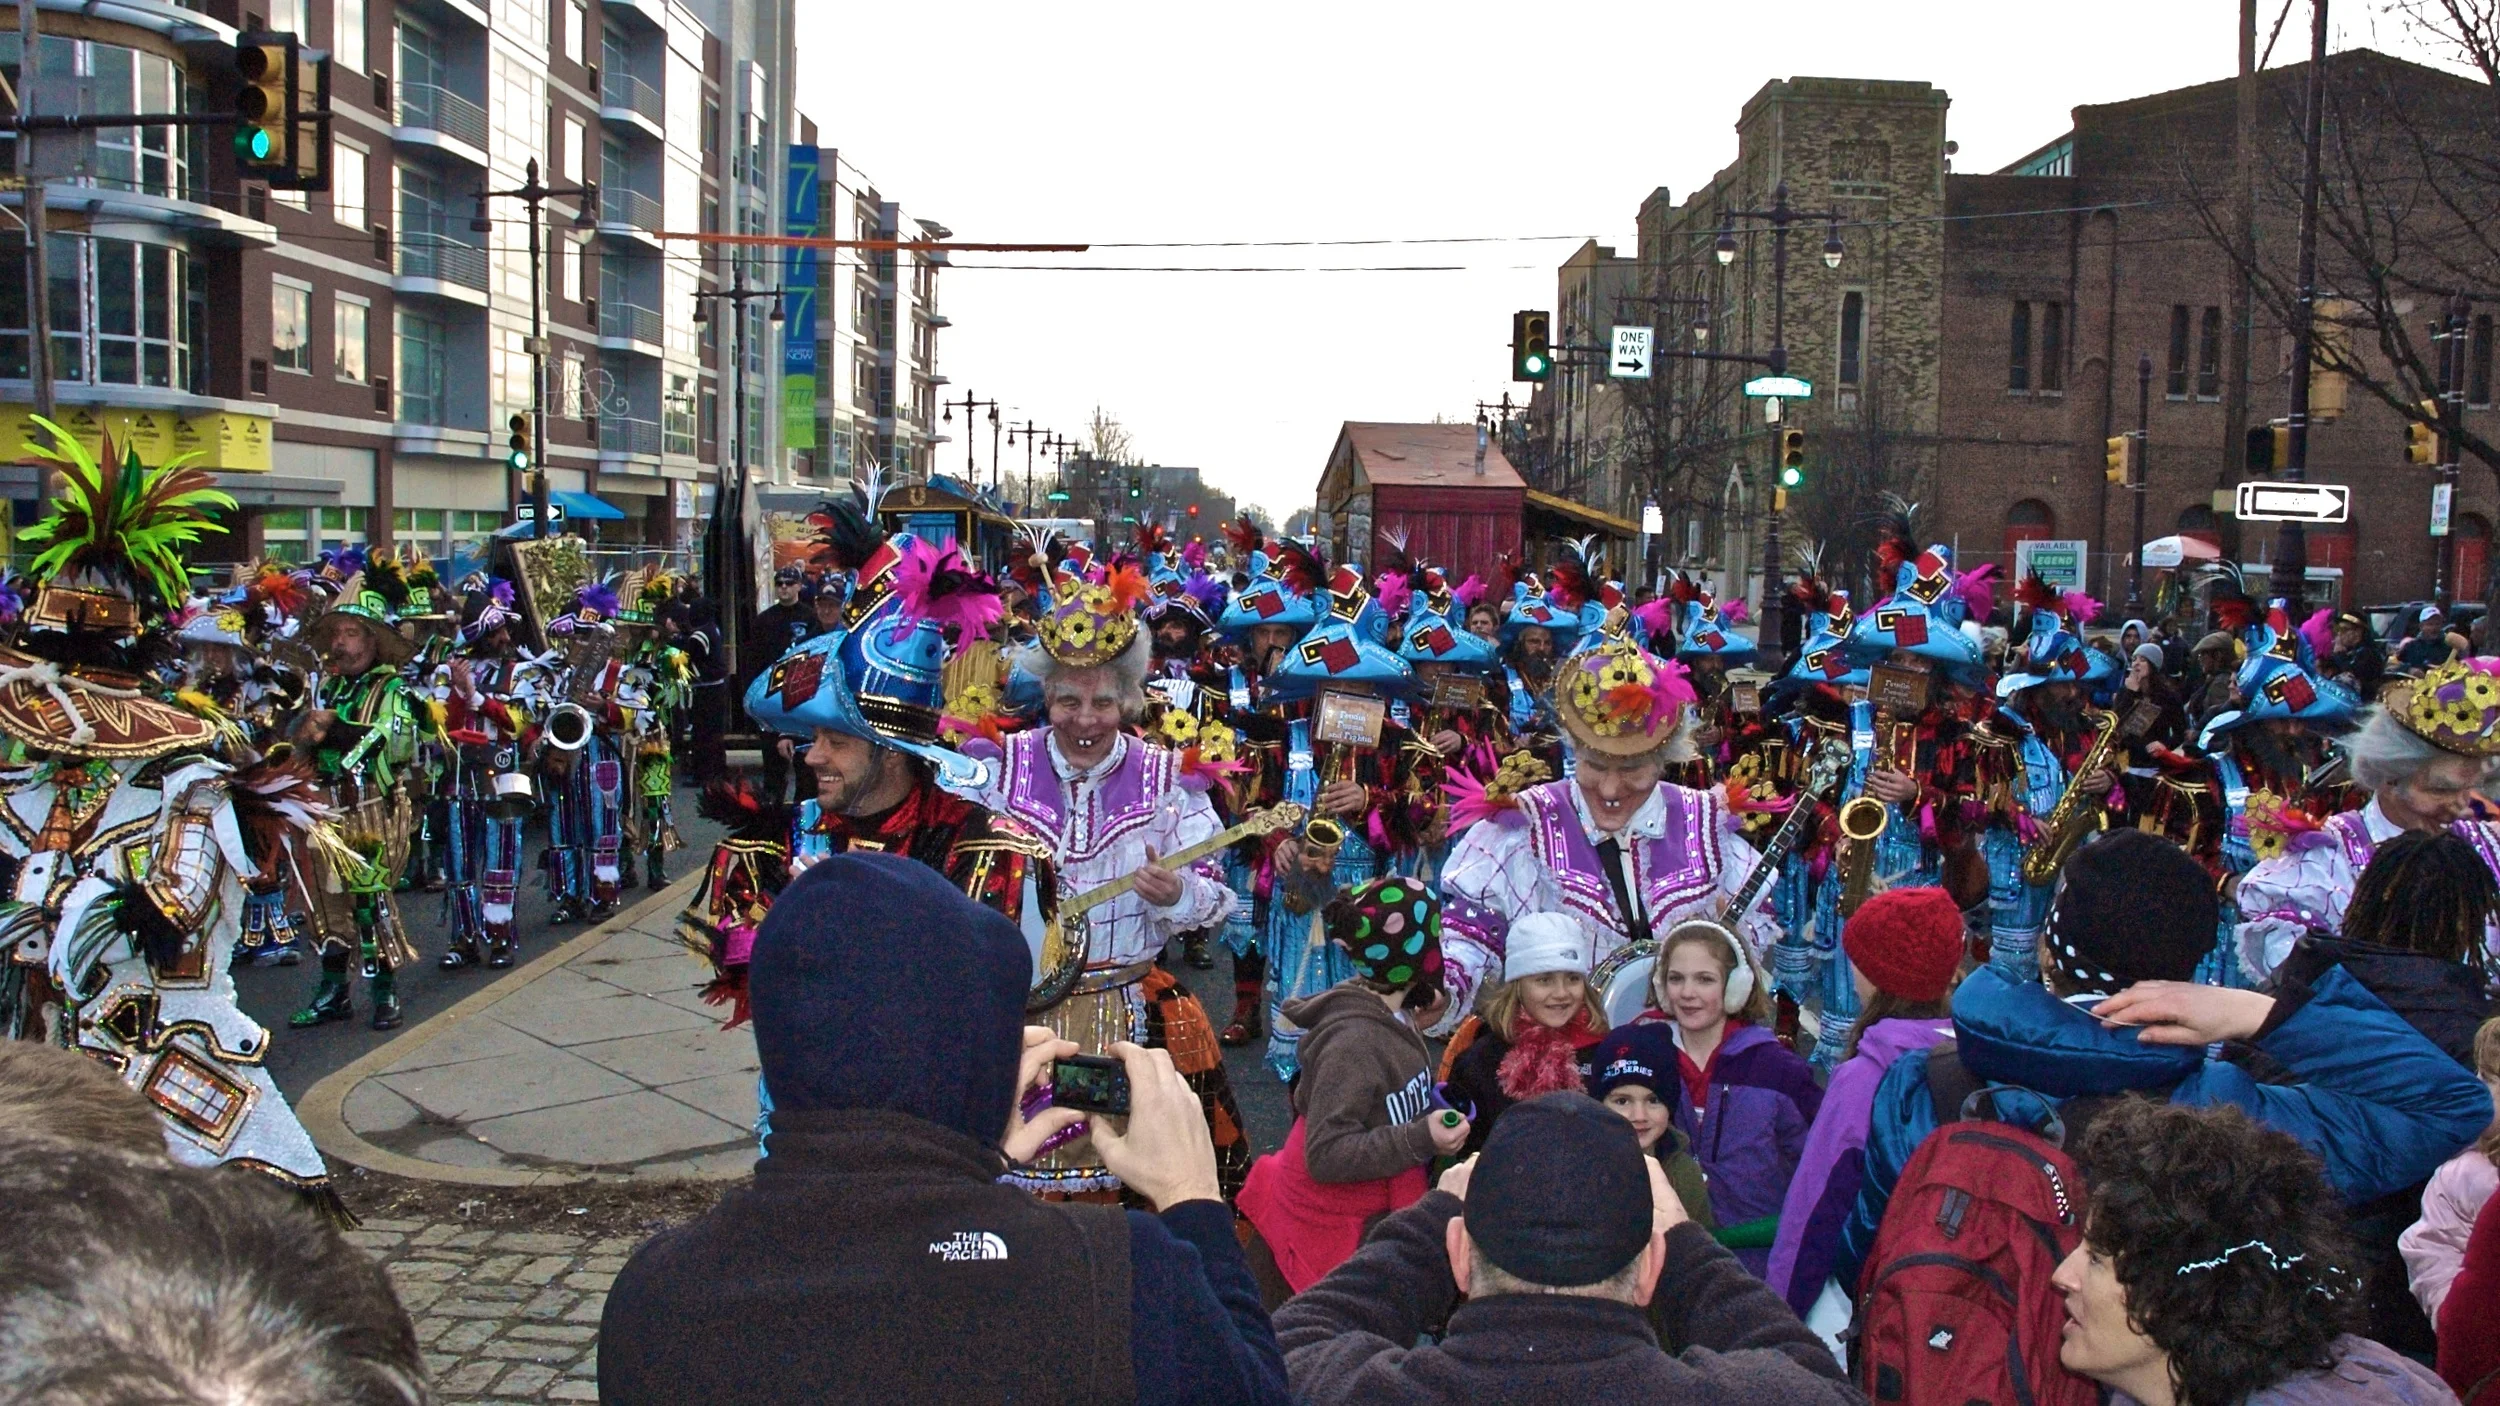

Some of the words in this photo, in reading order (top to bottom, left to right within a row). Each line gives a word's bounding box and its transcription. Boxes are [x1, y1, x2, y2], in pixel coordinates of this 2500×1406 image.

[1620, 331, 1645, 343] ONE
[1619, 345, 1645, 356] WAY
[788, 389, 812, 405] 777
[1622, 1065, 1653, 1077] SERIES
[952, 1232, 981, 1242] THE
[929, 1240, 982, 1254] NORTH
[943, 1250, 980, 1261] FACE
